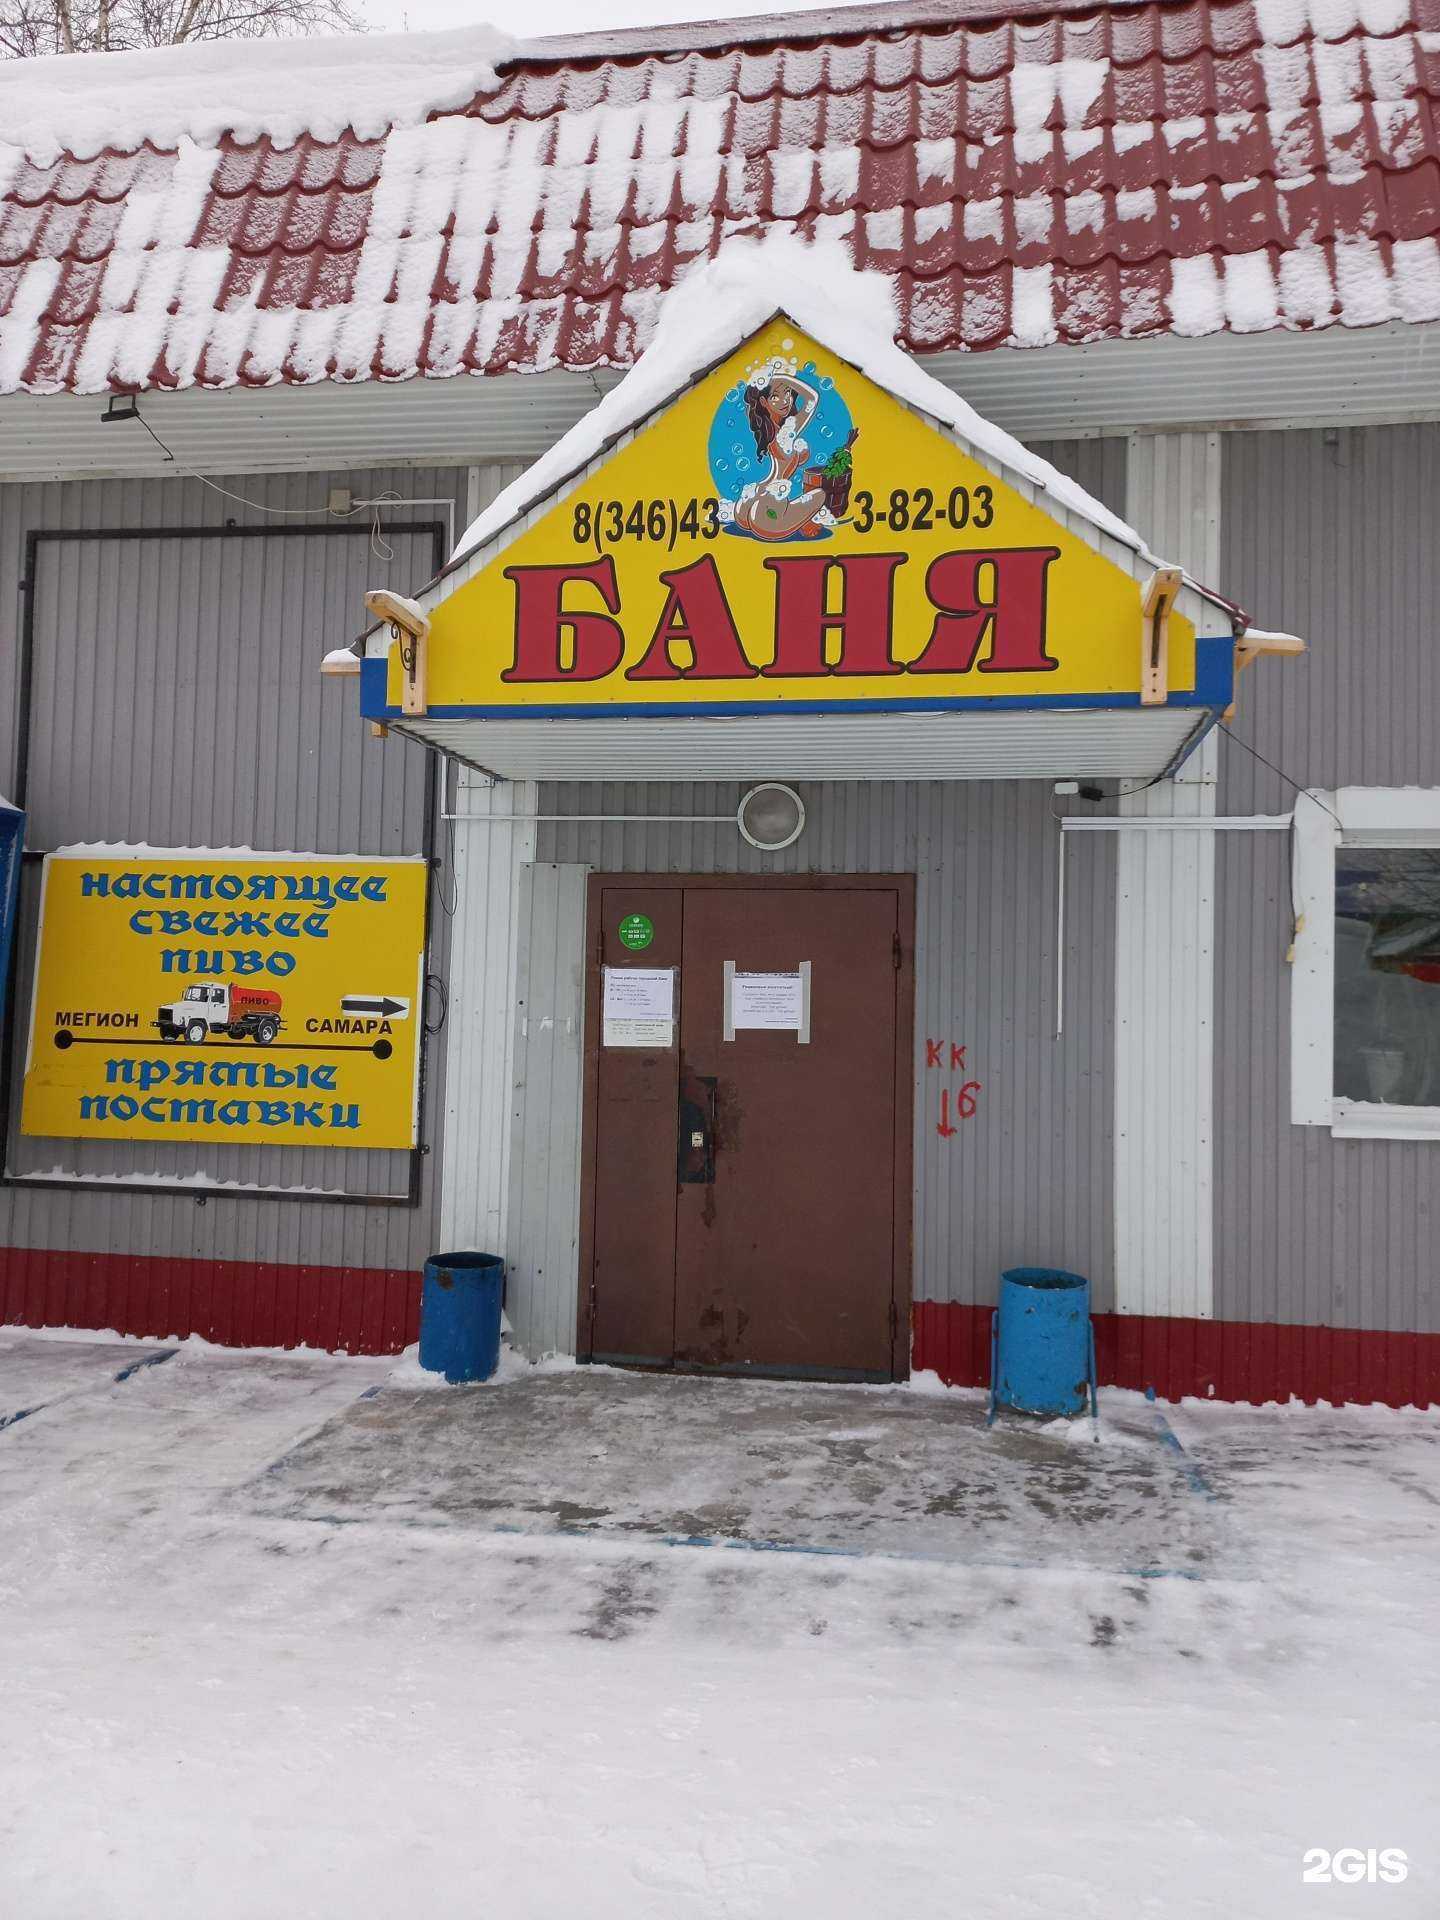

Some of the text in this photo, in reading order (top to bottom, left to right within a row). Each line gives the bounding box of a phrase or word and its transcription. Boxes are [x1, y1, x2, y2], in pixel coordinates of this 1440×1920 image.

[573, 485, 995, 553] 8(346)43 3-82-03
[501, 546, 1062, 683] БАНЯ
[55, 1011, 139, 1028] МЕГИОН
[305, 1018, 393, 1035] САМАРА
